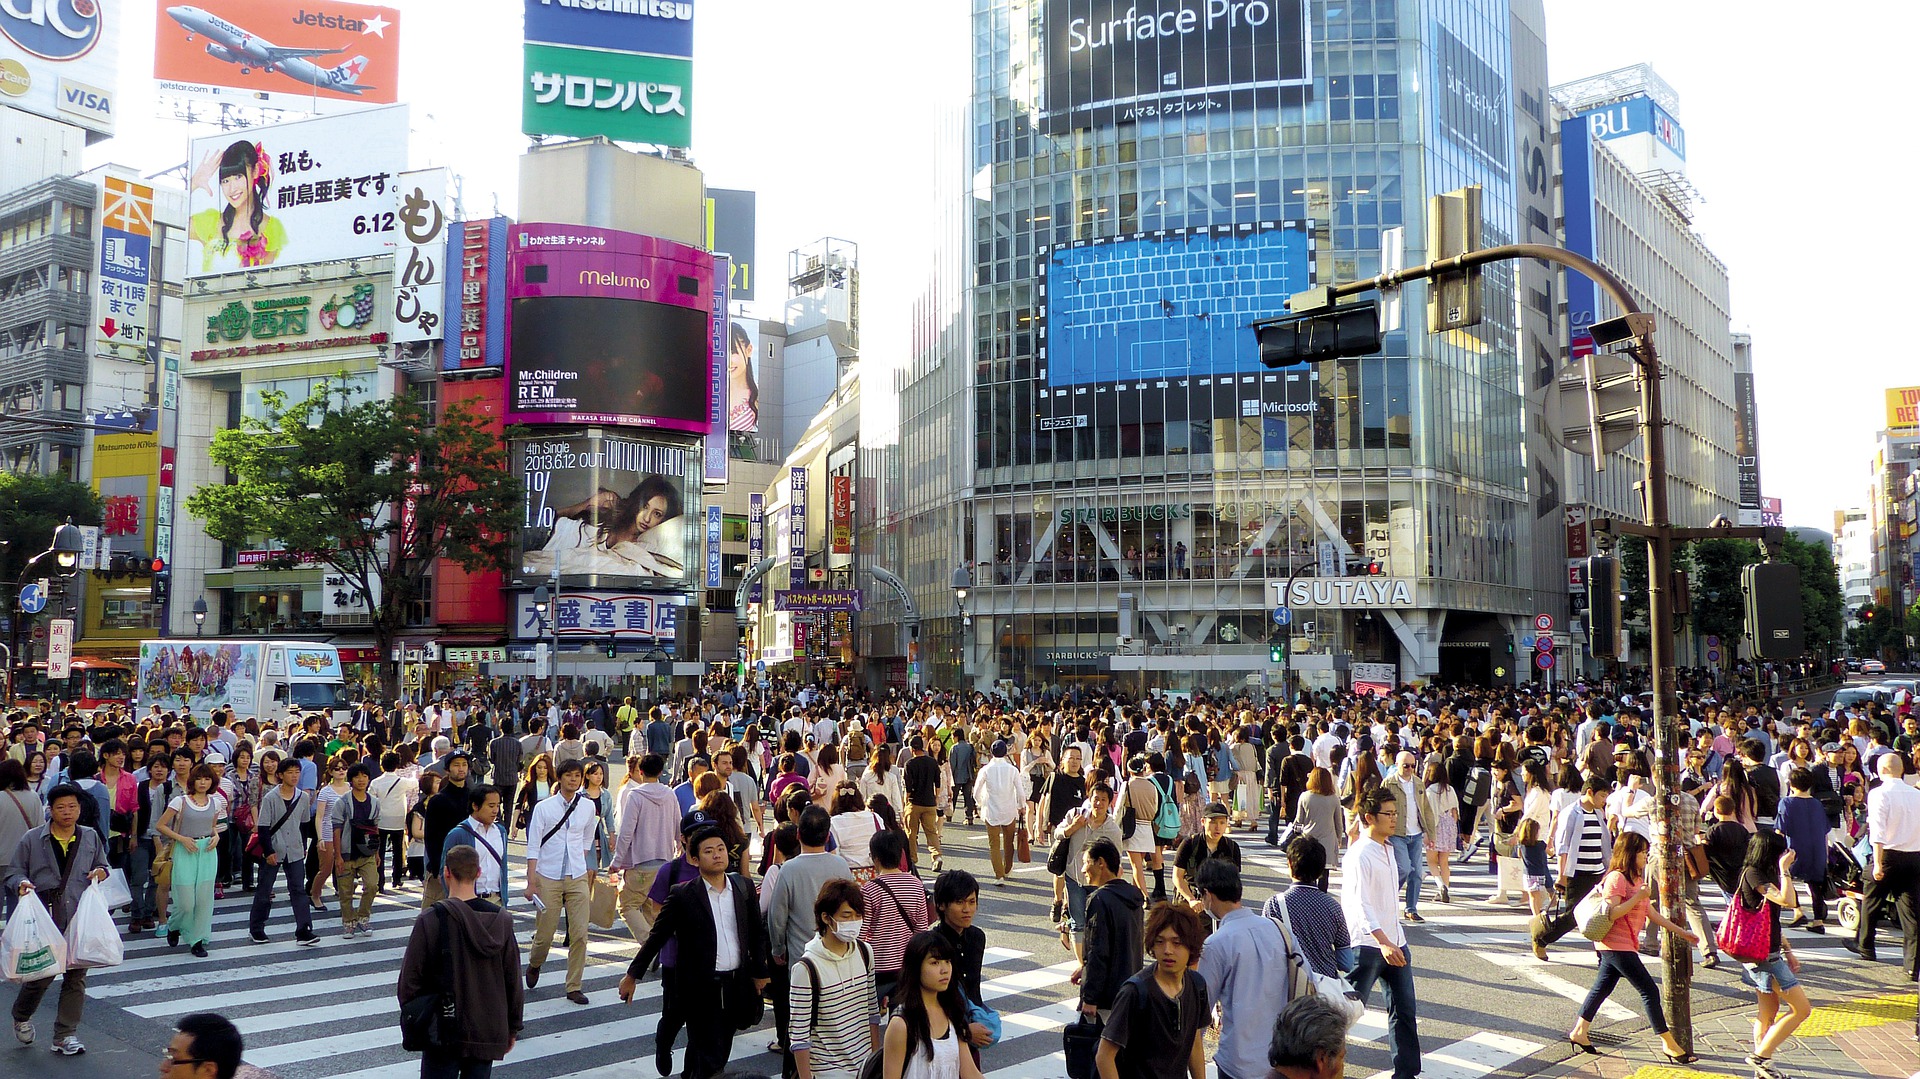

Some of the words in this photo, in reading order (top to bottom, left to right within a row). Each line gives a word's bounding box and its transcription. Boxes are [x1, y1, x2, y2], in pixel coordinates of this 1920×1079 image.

[208, 16, 245, 39] Jetstar
[292, 9, 365, 32] Jetstar
[1069, 7, 1196, 51] Surface
[1208, 0, 1269, 31] Pro
[64, 84, 111, 115] VISA
[160, 82, 208, 94] jetstar.com
[530, 71, 685, 117] サロンパス
[278, 149, 322, 175] 私も、
[103, 182, 152, 233] 本
[353, 211, 395, 235] 6.12
[529, 235, 566, 246] わかさ生活
[567, 235, 606, 246] チャンネル
[392, 186, 443, 336] もんじゃ
[101, 280, 146, 302] 夜11時
[460, 224, 483, 360] 三千里薬品
[110, 299, 137, 317] まで
[121, 322, 146, 342] 地下
[251, 307, 309, 339] 西村
[519, 369, 578, 380] Mr.Children
[518, 385, 555, 399] REM
[1262, 400, 1318, 413] Microsoft
[599, 415, 628, 423] SEIKATSU
[628, 416, 657, 425] CHANNEL
[1043, 419, 1072, 427] サーフェス
[97, 444, 137, 453] Matsumoto
[526, 442, 541, 455] 4th
[543, 440, 570, 455] Single
[525, 453, 576, 471] 2013.6.12
[579, 452, 606, 468] OUT
[524, 471, 553, 528] 1%
[791, 471, 805, 549] 洋服の青山
[104, 495, 140, 536] 薬
[1060, 503, 1195, 525] STARBUCKS
[1208, 500, 1298, 518] COFFEE
[708, 511, 720, 582] 大盛堂商事ビル
[239, 554, 267, 563] 国内旅行
[1271, 580, 1412, 606] TSUTAYA
[524, 599, 676, 631] 大盛堂書店
[51, 625, 64, 673] 道玄坂
[449, 650, 501, 661] 三千里薬品
[1046, 651, 1098, 660] STARBUCKS
